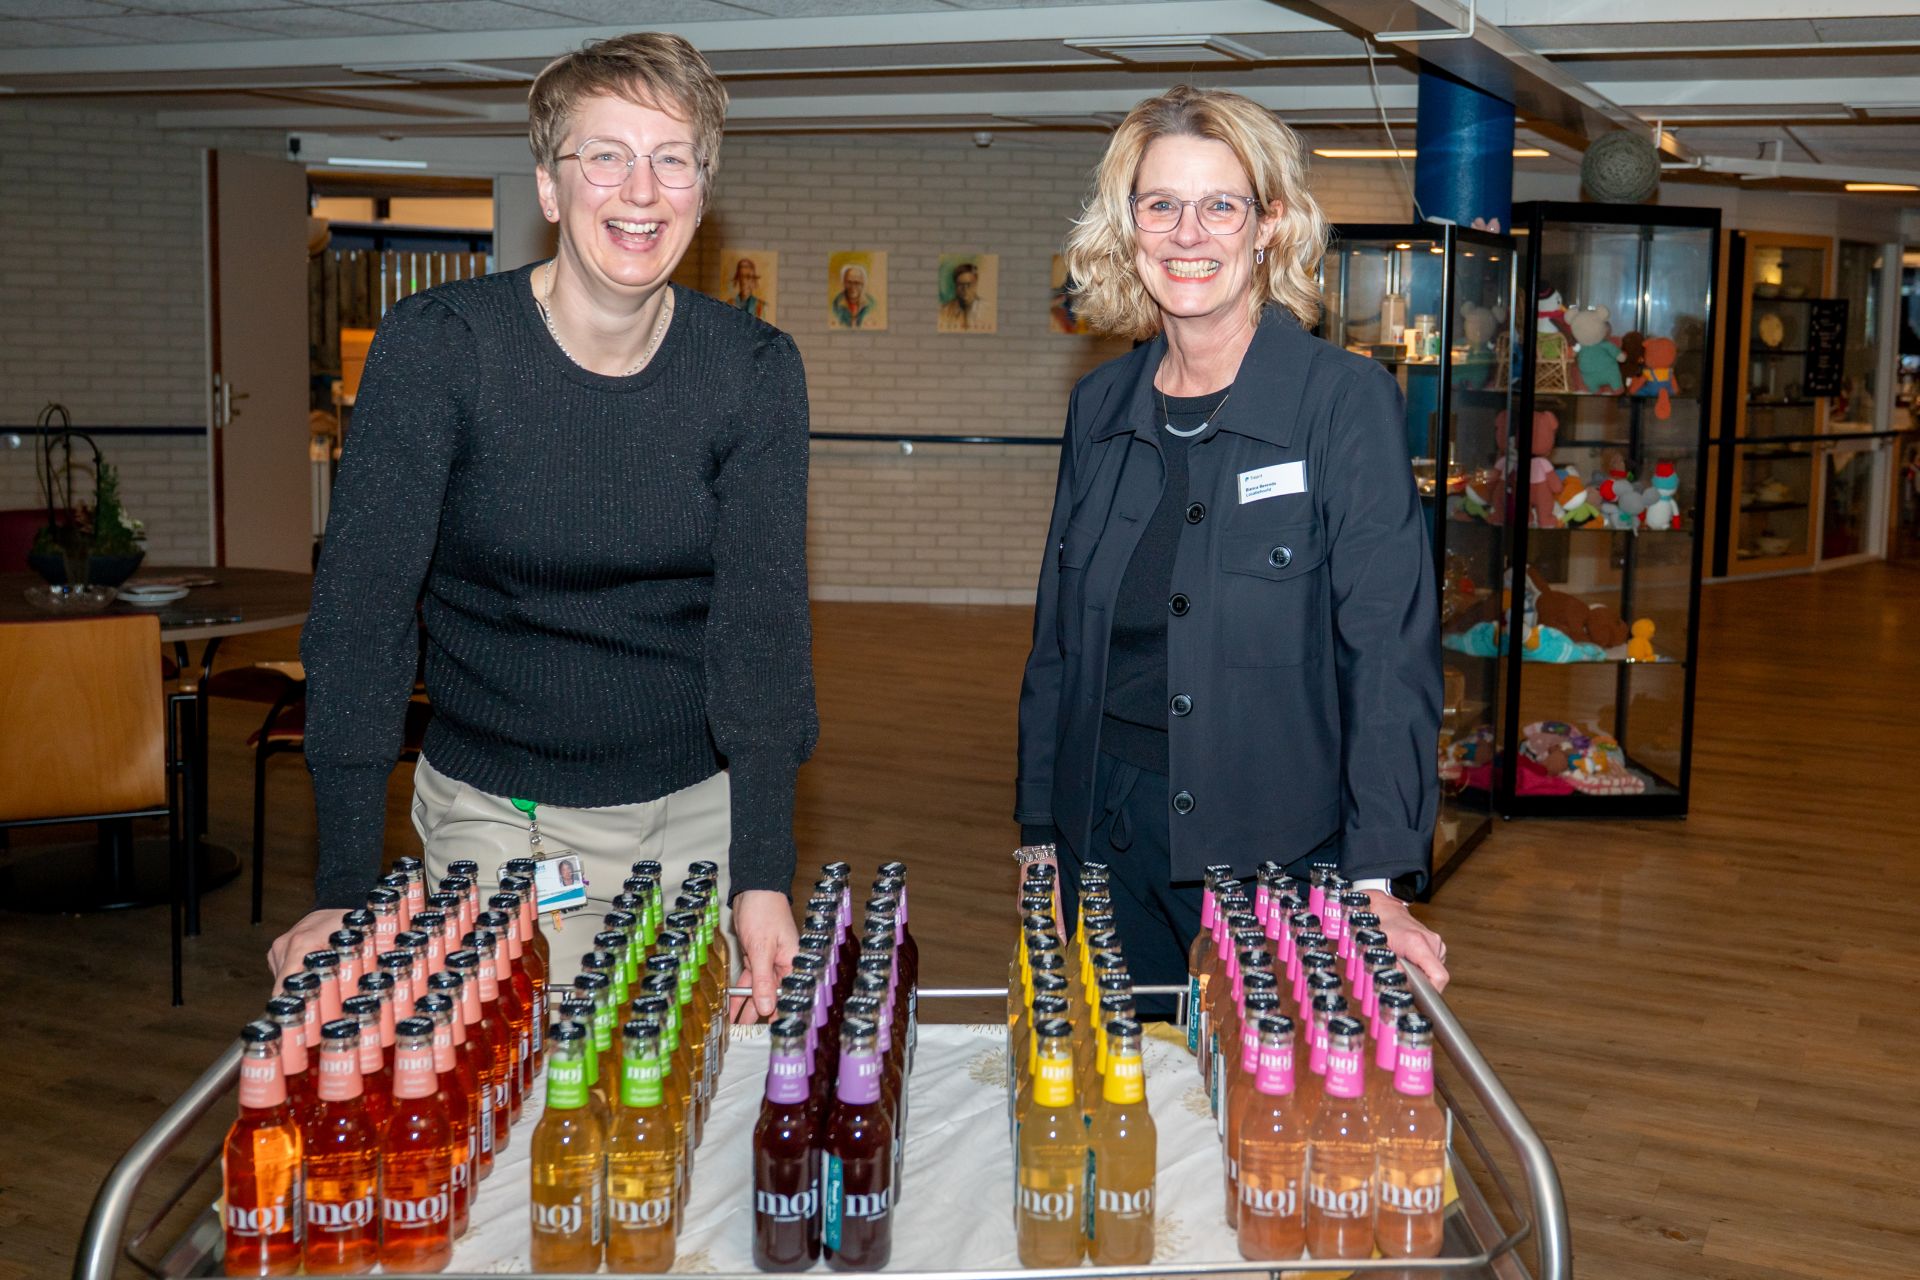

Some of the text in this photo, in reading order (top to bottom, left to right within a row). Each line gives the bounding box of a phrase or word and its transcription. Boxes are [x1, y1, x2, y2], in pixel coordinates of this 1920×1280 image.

[1260, 1051, 1293, 1072] moj
[1328, 1054, 1358, 1075] moj
[1400, 1052, 1431, 1073] moj
[307, 1186, 374, 1227] moj
[383, 1183, 449, 1224] moj
[609, 1187, 671, 1227] moj
[756, 1178, 819, 1220] moj
[845, 1187, 890, 1217] mo
[1243, 1179, 1297, 1218] moj
[1310, 1179, 1369, 1219] moj
[1381, 1176, 1441, 1214] moj
